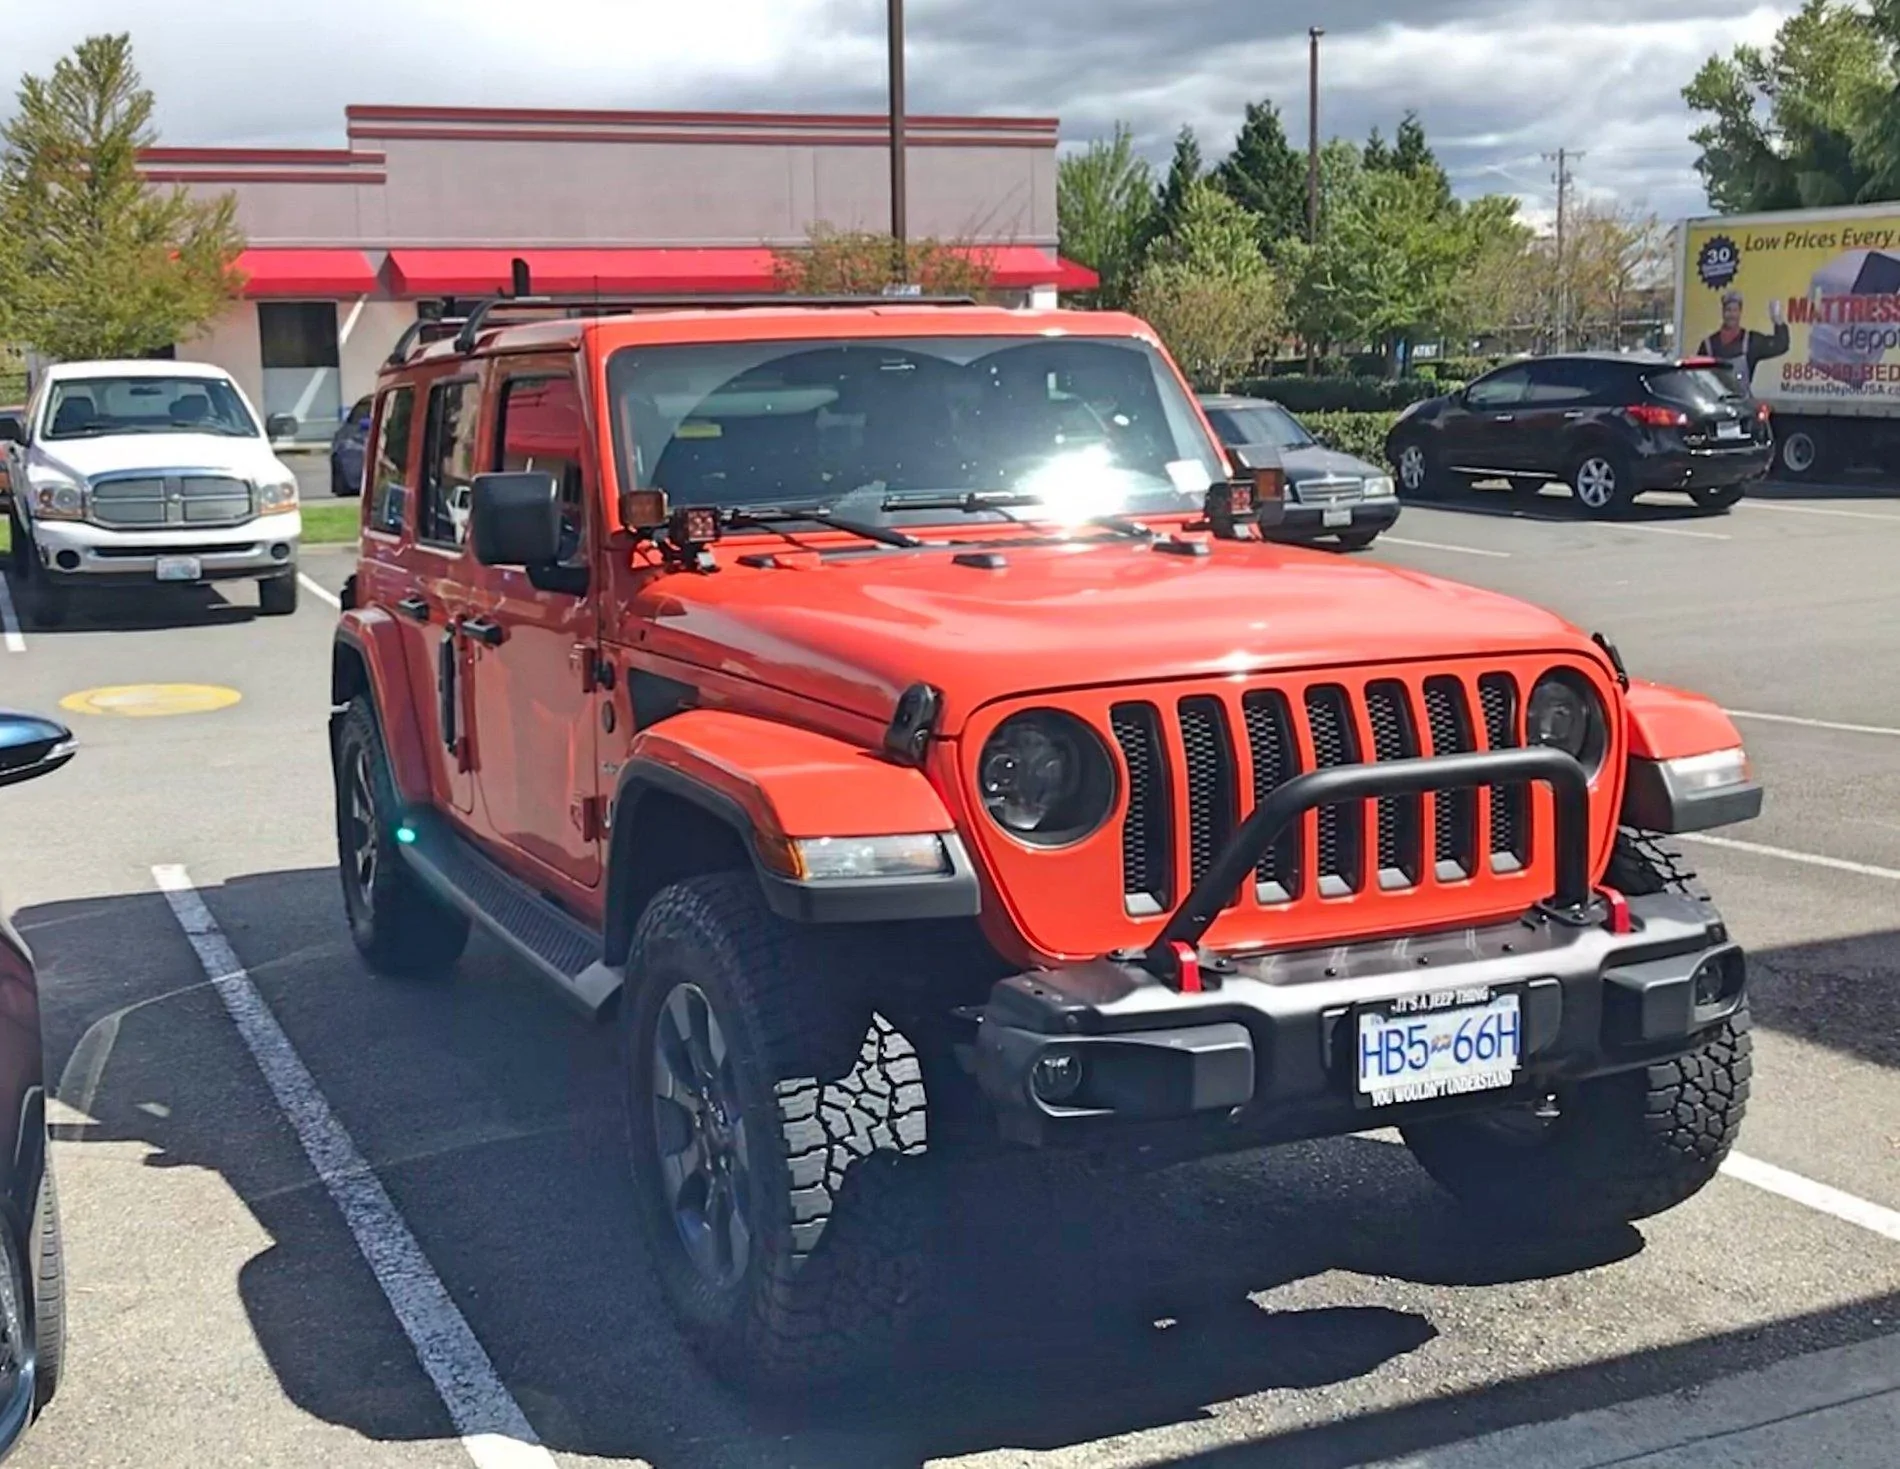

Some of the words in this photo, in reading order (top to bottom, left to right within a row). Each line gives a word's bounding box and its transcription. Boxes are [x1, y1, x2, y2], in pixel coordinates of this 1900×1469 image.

[1745, 234, 1780, 252] Low
[1783, 231, 1836, 249] Prices
[1841, 228, 1894, 248] Every
[1707, 247, 1731, 265] 30
[1412, 344, 1438, 357] AT&T
[1418, 995, 1427, 1009] A
[1428, 992, 1454, 1010] JEEP
[1456, 986, 1489, 1004] THING
[1371, 1088, 1393, 1106] YOU
[1394, 1079, 1447, 1102] WOULDN'T
[1447, 1070, 1513, 1095] UNDERSTAND
